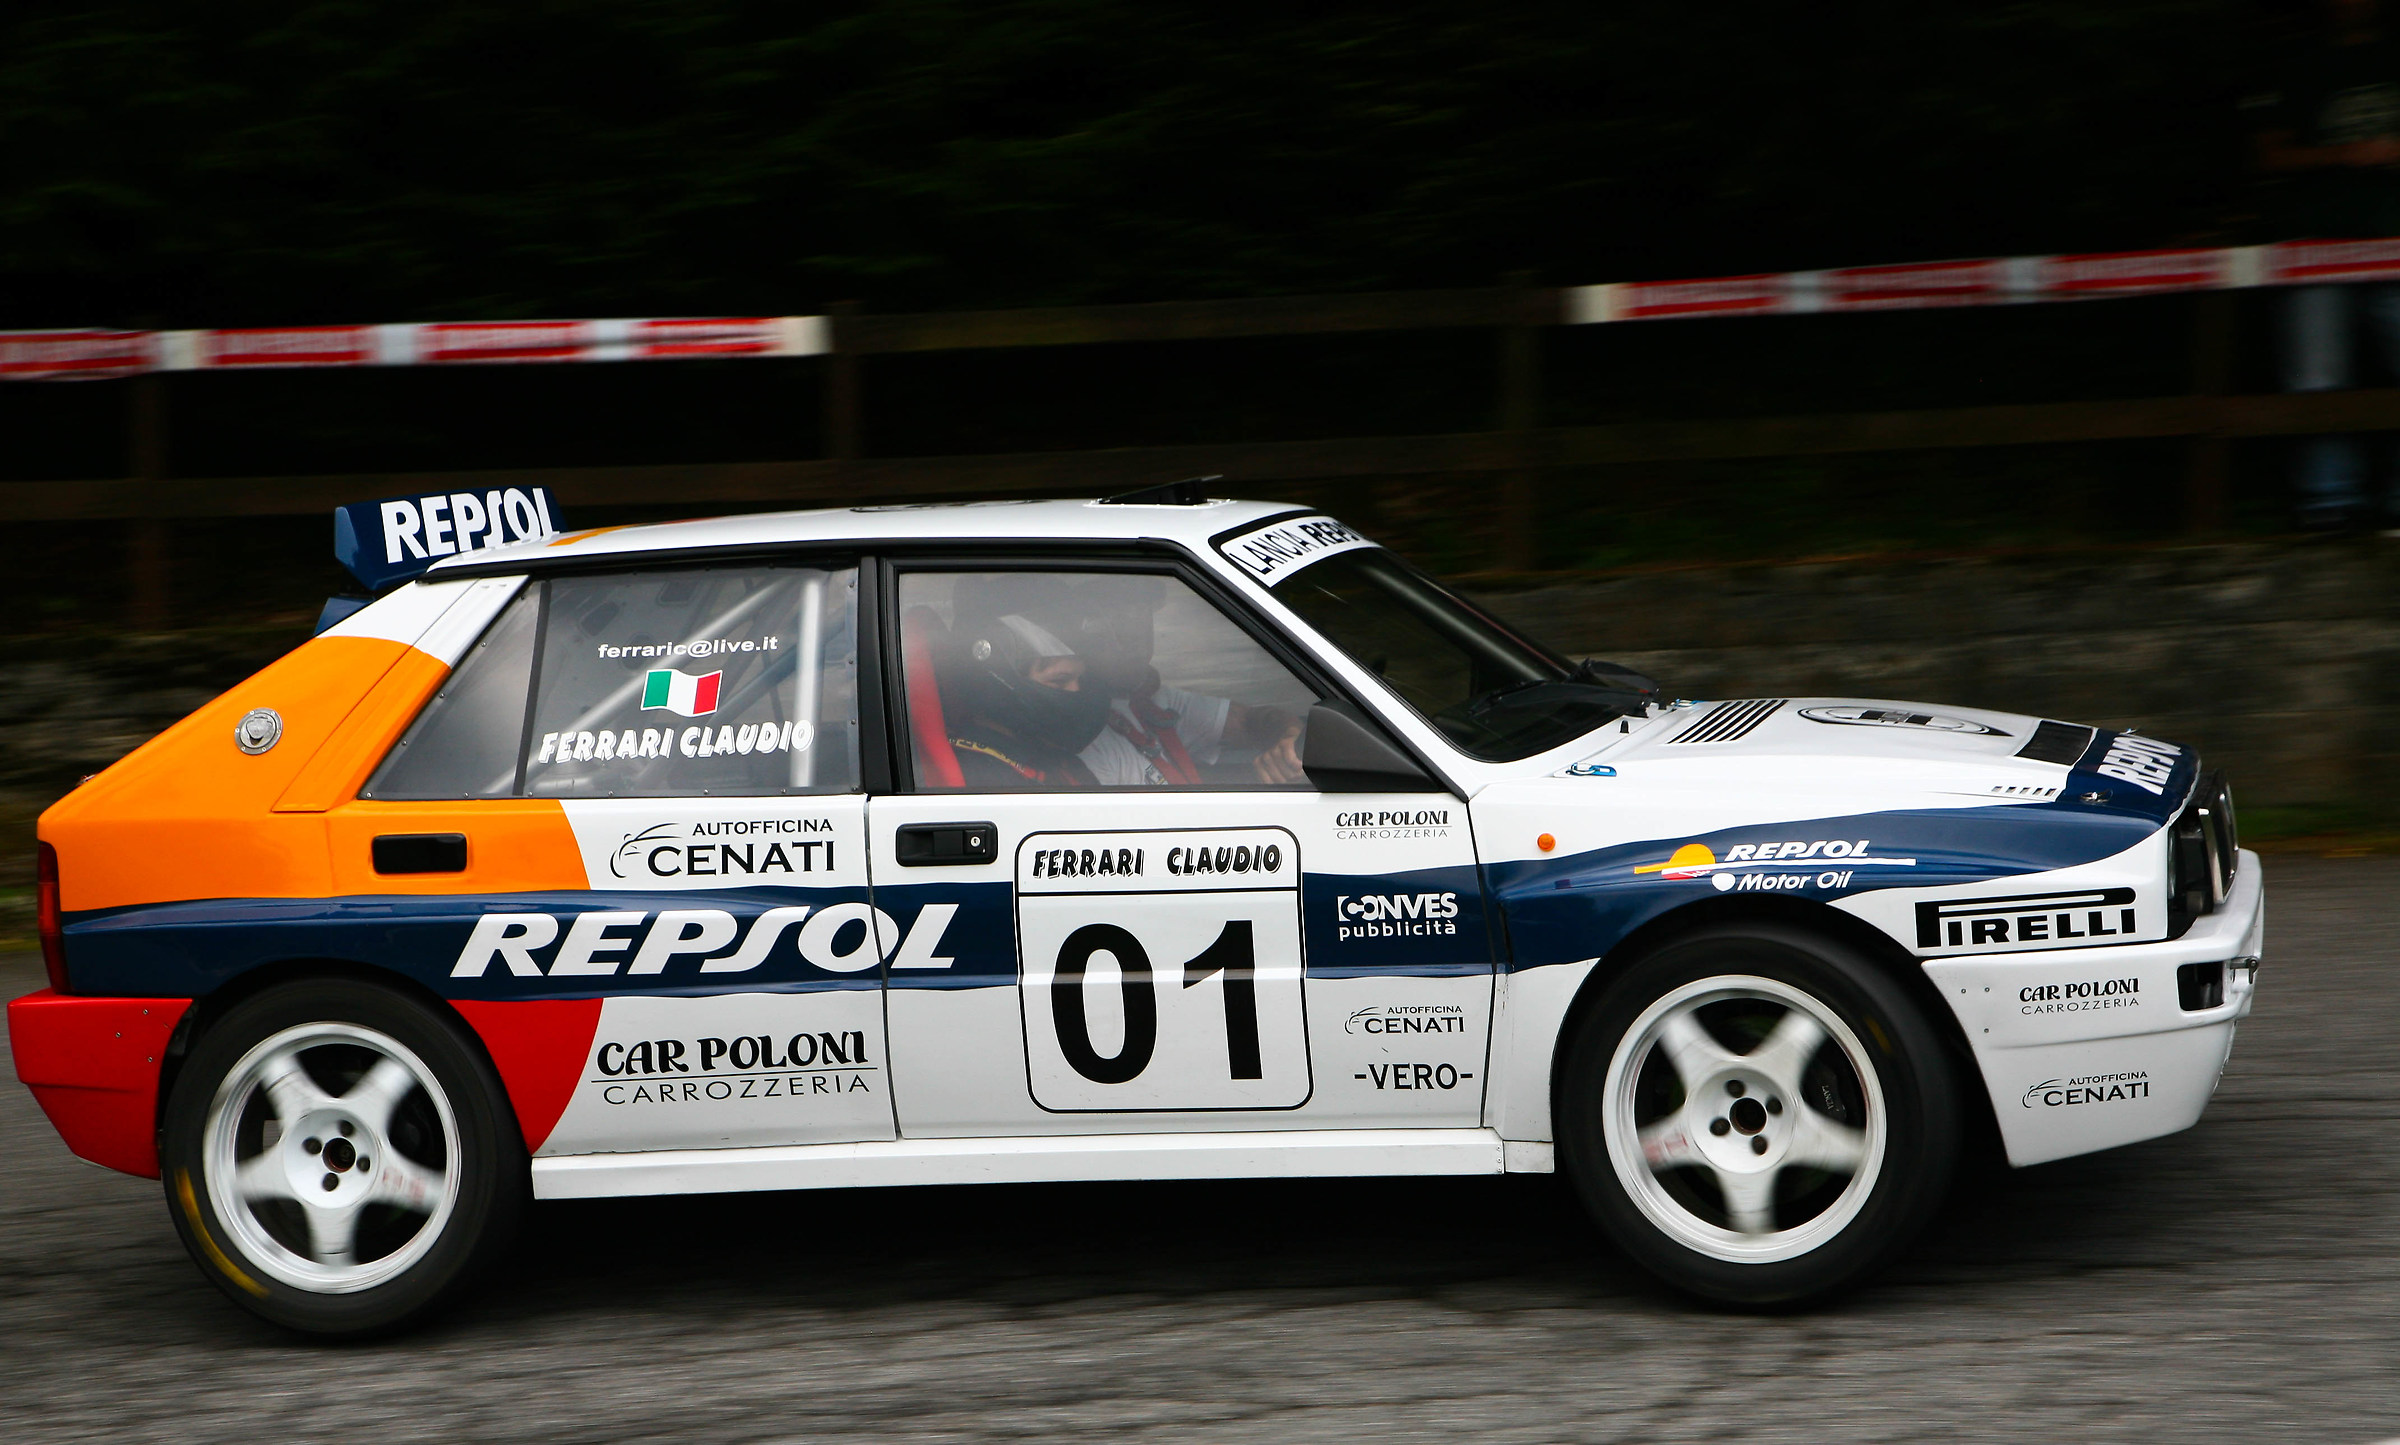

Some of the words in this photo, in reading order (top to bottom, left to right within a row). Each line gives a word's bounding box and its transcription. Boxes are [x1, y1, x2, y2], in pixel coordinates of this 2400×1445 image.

[1229, 528, 1320, 575] LANCIA
[598, 636, 778, 659] ferraric@live.it
[538, 728, 674, 763] FERRARI
[679, 720, 815, 758] CLAUDIO
[692, 818, 834, 836] AUTOFFICINA
[1336, 811, 1374, 827] CAR
[1379, 810, 1449, 826] POLONI
[1336, 829, 1448, 840] CARROZZERIA
[648, 840, 835, 877] CENATI
[1032, 848, 1145, 879] FERRARI
[1166, 844, 1283, 875] CLAUDIO
[1724, 840, 1870, 862] REPSOL
[1737, 871, 1811, 891] Motor
[1816, 870, 1853, 889] Oil
[1337, 892, 1459, 922] CONVES
[1914, 887, 2137, 949] PIRELLI
[449, 902, 960, 978] REPSOL
[1339, 919, 1457, 942] pubblicità
[1050, 919, 1263, 1085] 01
[2019, 984, 2061, 1002] CAR
[2065, 977, 2140, 999] POLONI
[1387, 1005, 1463, 1015] AUTOFFICINA
[2021, 997, 2140, 1015] CARROZZERIA
[1364, 1016, 1465, 1034] CENATI
[596, 1038, 689, 1076] CAR
[697, 1030, 869, 1071] POLONI
[1354, 1062, 1474, 1091] -VERO-
[2068, 1071, 2148, 1086] AUTOFFICINA
[602, 1073, 870, 1106] CARROZZERIA
[2043, 1081, 2150, 1107] CENATI
